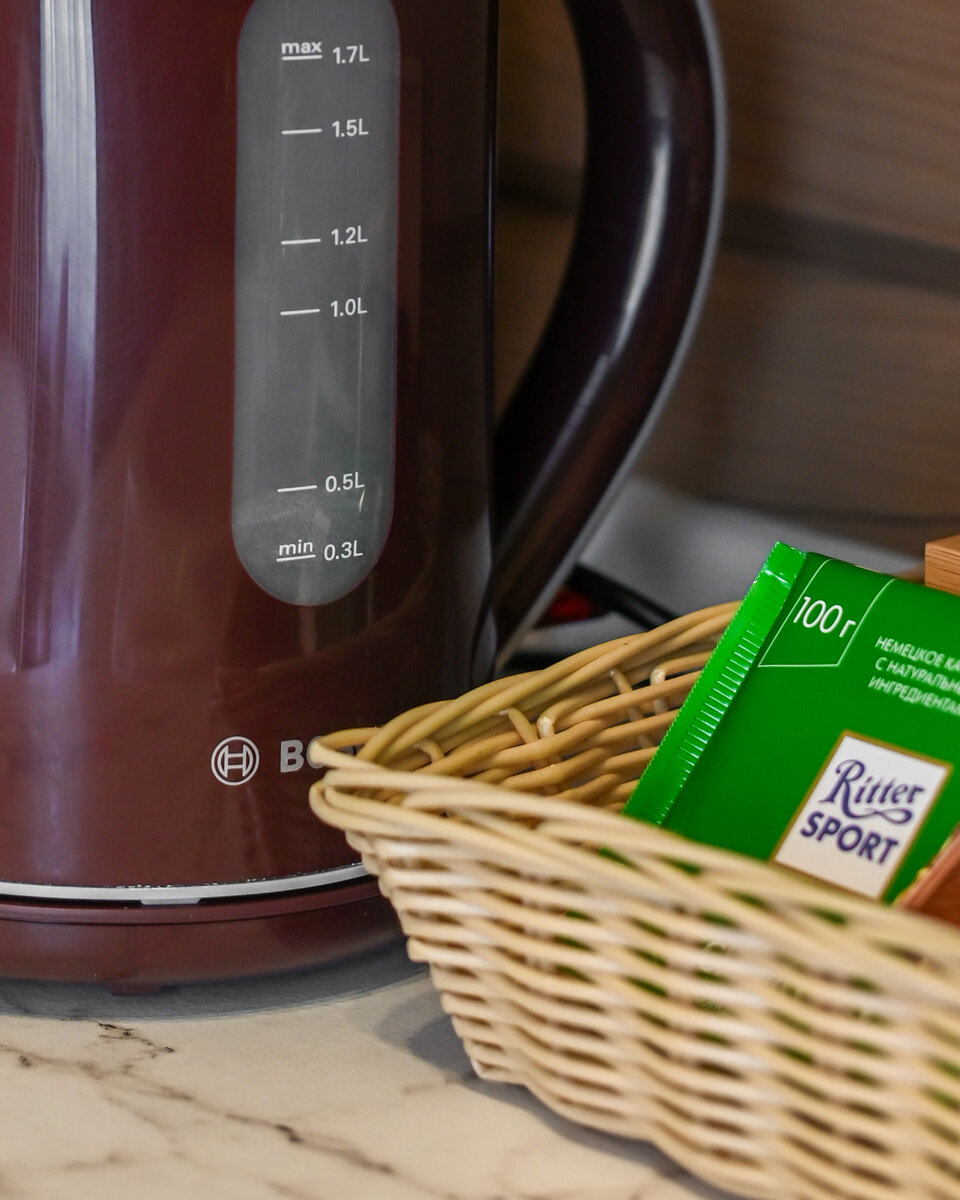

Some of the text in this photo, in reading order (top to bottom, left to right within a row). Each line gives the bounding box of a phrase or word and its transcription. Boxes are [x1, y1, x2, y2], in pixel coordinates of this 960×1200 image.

[281, 40, 370, 64] max 1.7L
[331, 118, 369, 137] 1.5L
[331, 225, 368, 245] 1.2L
[330, 297, 368, 317] 1.0L
[325, 472, 365, 492] 0.5L
[278, 539, 364, 561] min 0.3L
[793, 596, 844, 634] 100
[874, 635, 945, 668] НЕМЕЦКОЕ
[818, 759, 926, 825] Ritter
[800, 810, 899, 865] SPORT
